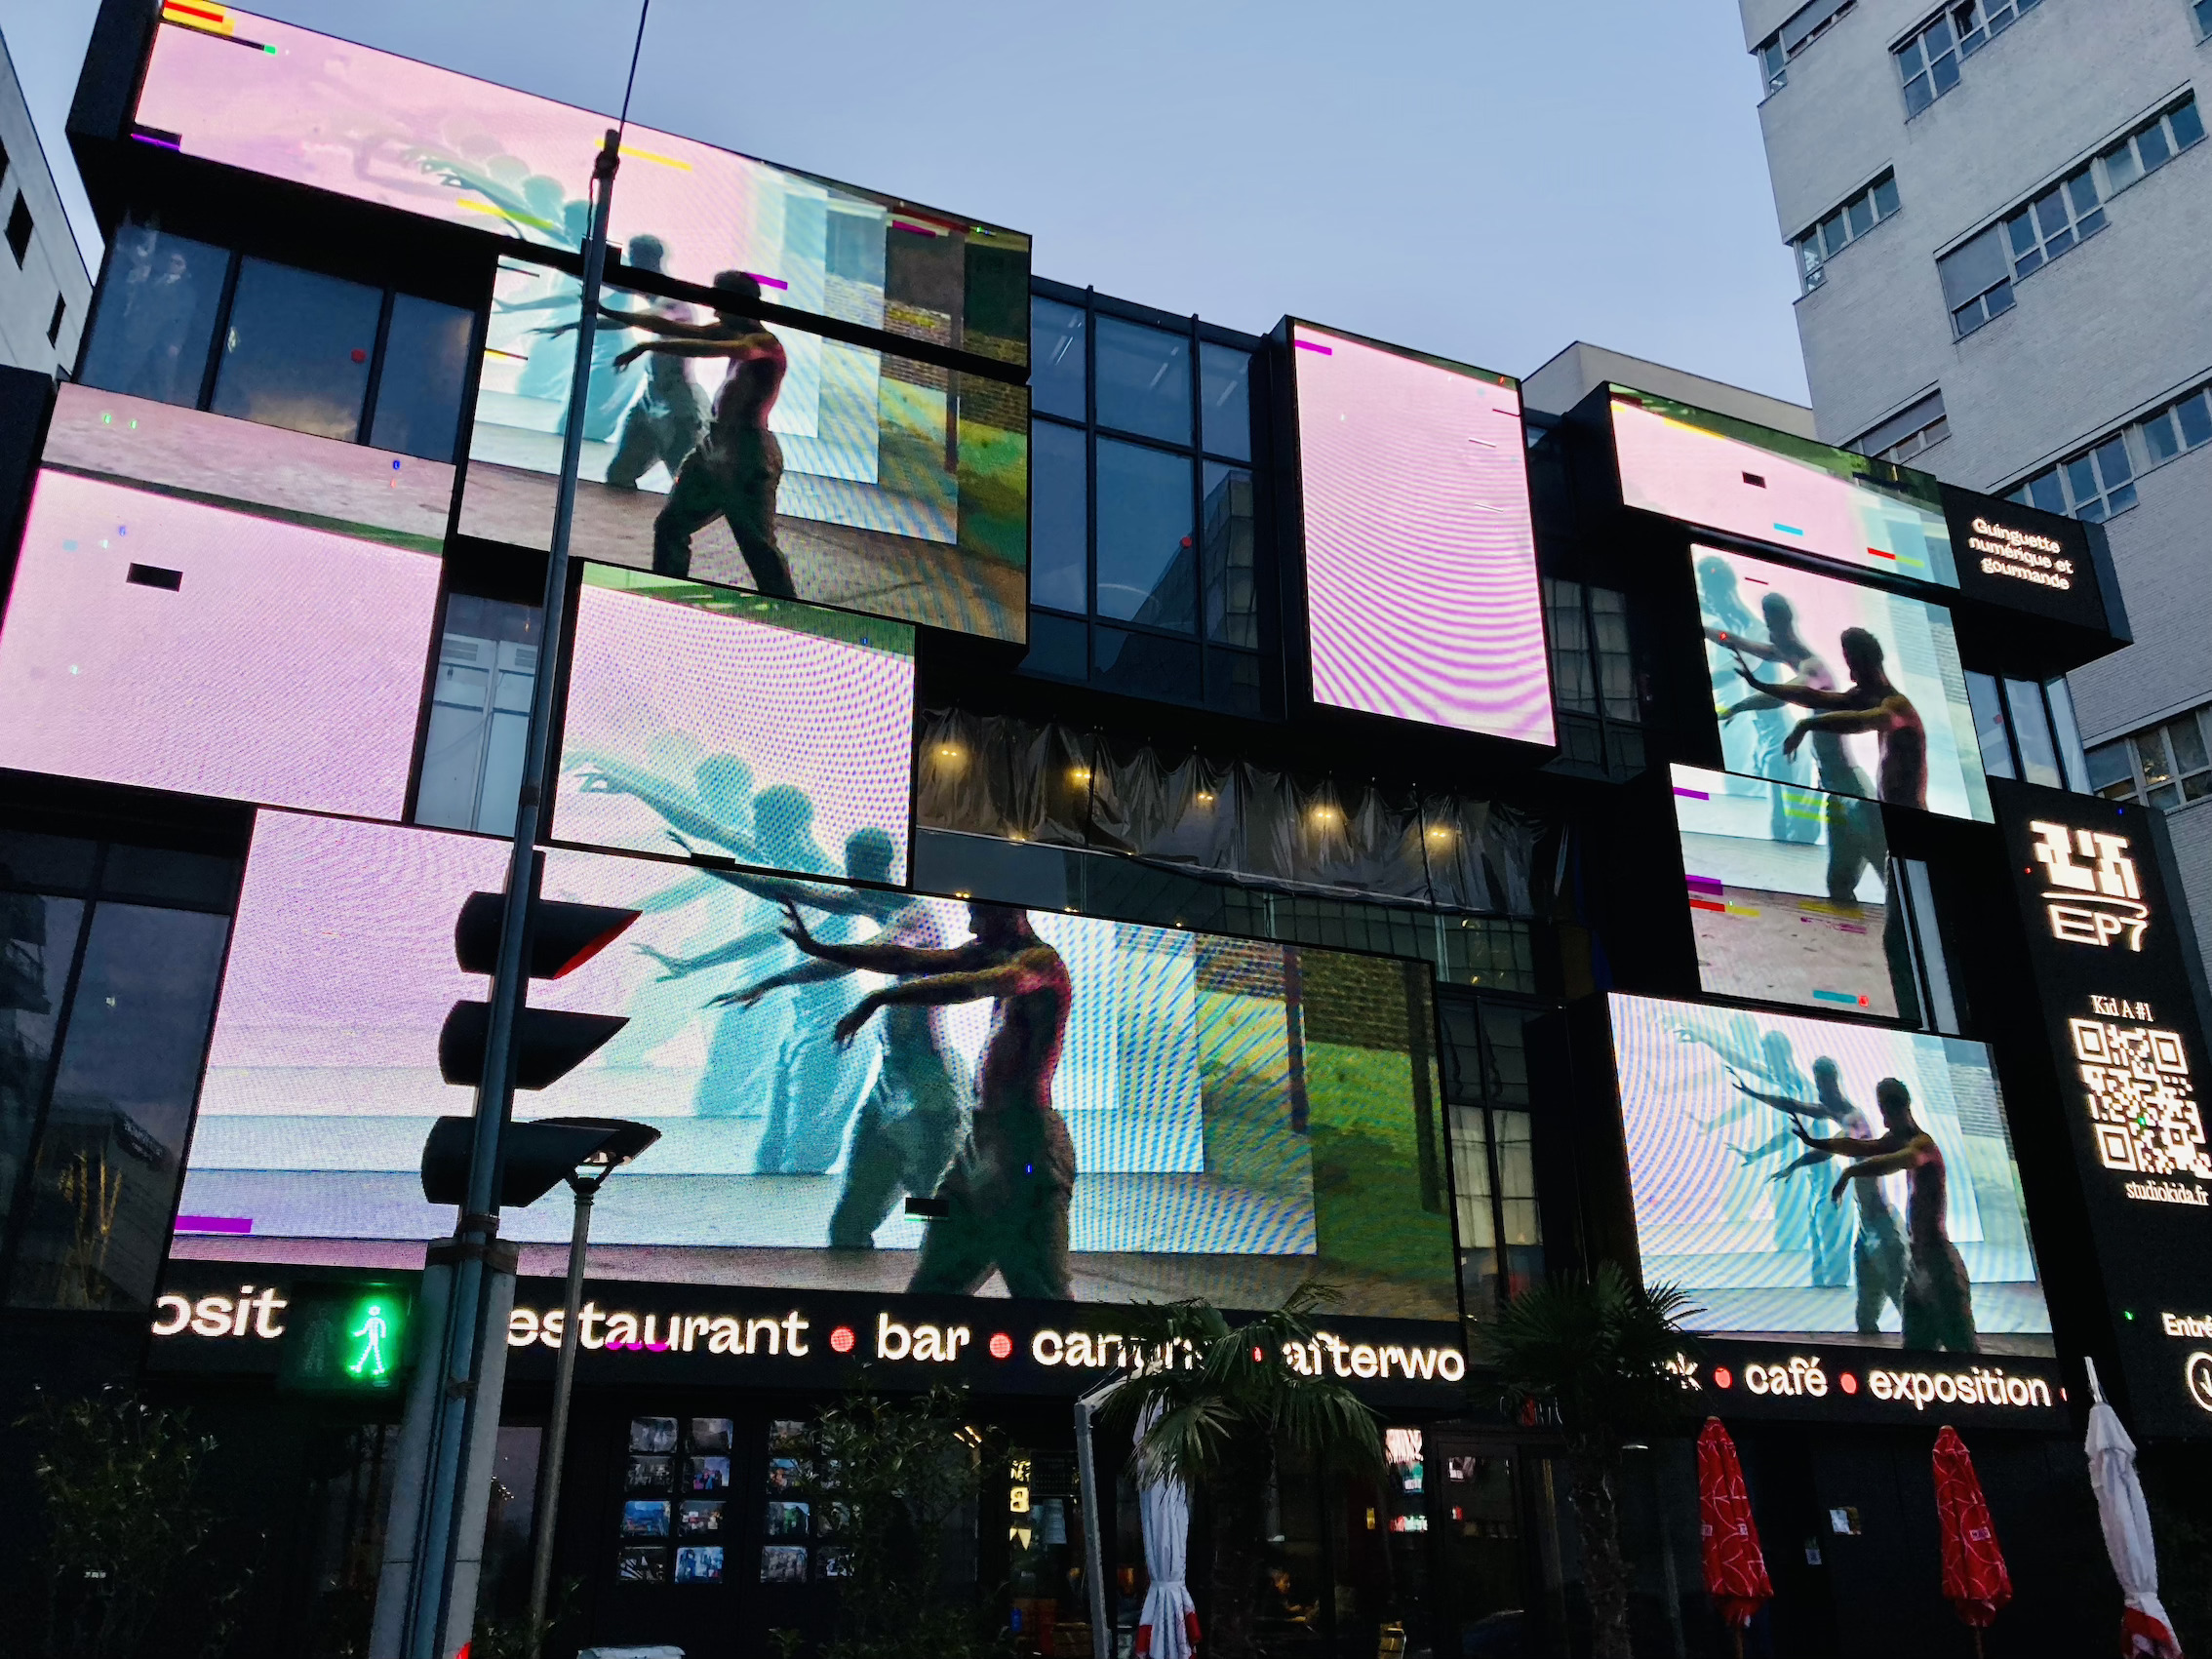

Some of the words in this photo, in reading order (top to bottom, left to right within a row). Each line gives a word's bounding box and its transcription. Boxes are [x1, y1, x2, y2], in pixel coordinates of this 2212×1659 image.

[1972, 518, 2061, 554] Guinguette
[1968, 536, 2053, 570] numérique
[2055, 559, 2074, 574] et
[1980, 556, 2071, 590] gourmande
[2048, 904, 2149, 952] EP7
[2090, 995, 2120, 1016] Kid
[2122, 1000, 2136, 1019] A
[2124, 1181, 2209, 1206] studiokida.fr
[507, 1301, 810, 1358] estaurant
[877, 1312, 970, 1363] bar
[1744, 1356, 1829, 1398] café
[1868, 1365, 2052, 1411] exposition
